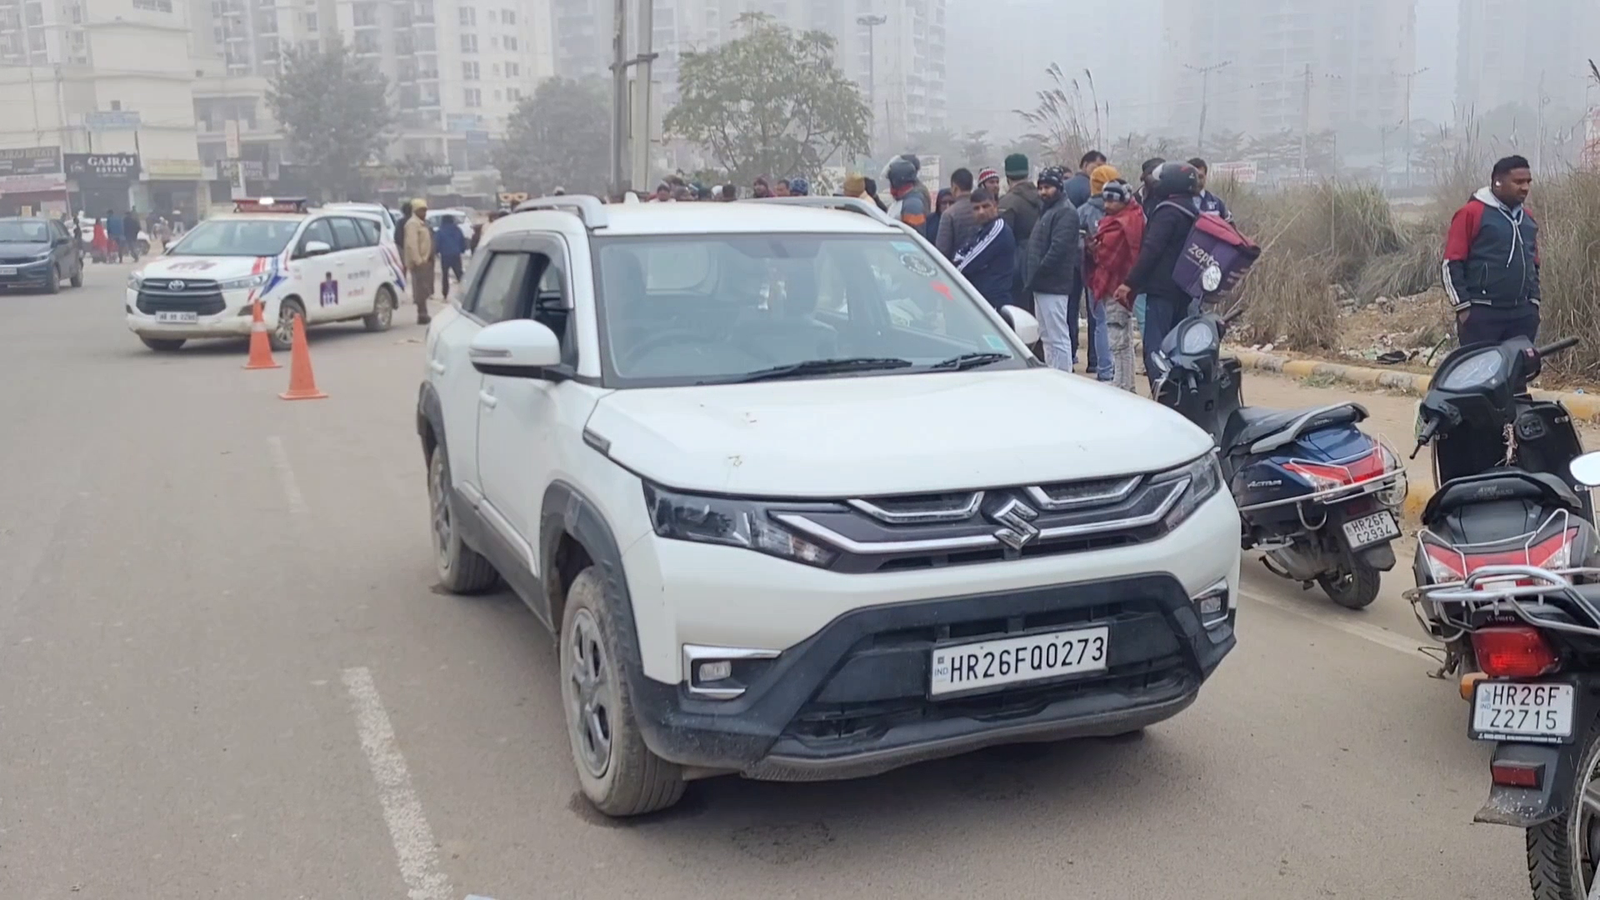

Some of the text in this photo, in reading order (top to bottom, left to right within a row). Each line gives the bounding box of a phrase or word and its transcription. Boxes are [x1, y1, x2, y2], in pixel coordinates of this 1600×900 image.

[87, 156, 134, 167] GAJRAJ
[1351, 513, 1386, 533] HR26F
[1357, 526, 1393, 544] C2934
[934, 636, 1105, 683] IND HR26FQ0273
[1492, 685, 1560, 706] HR26F
[1490, 708, 1558, 730] Z2715
